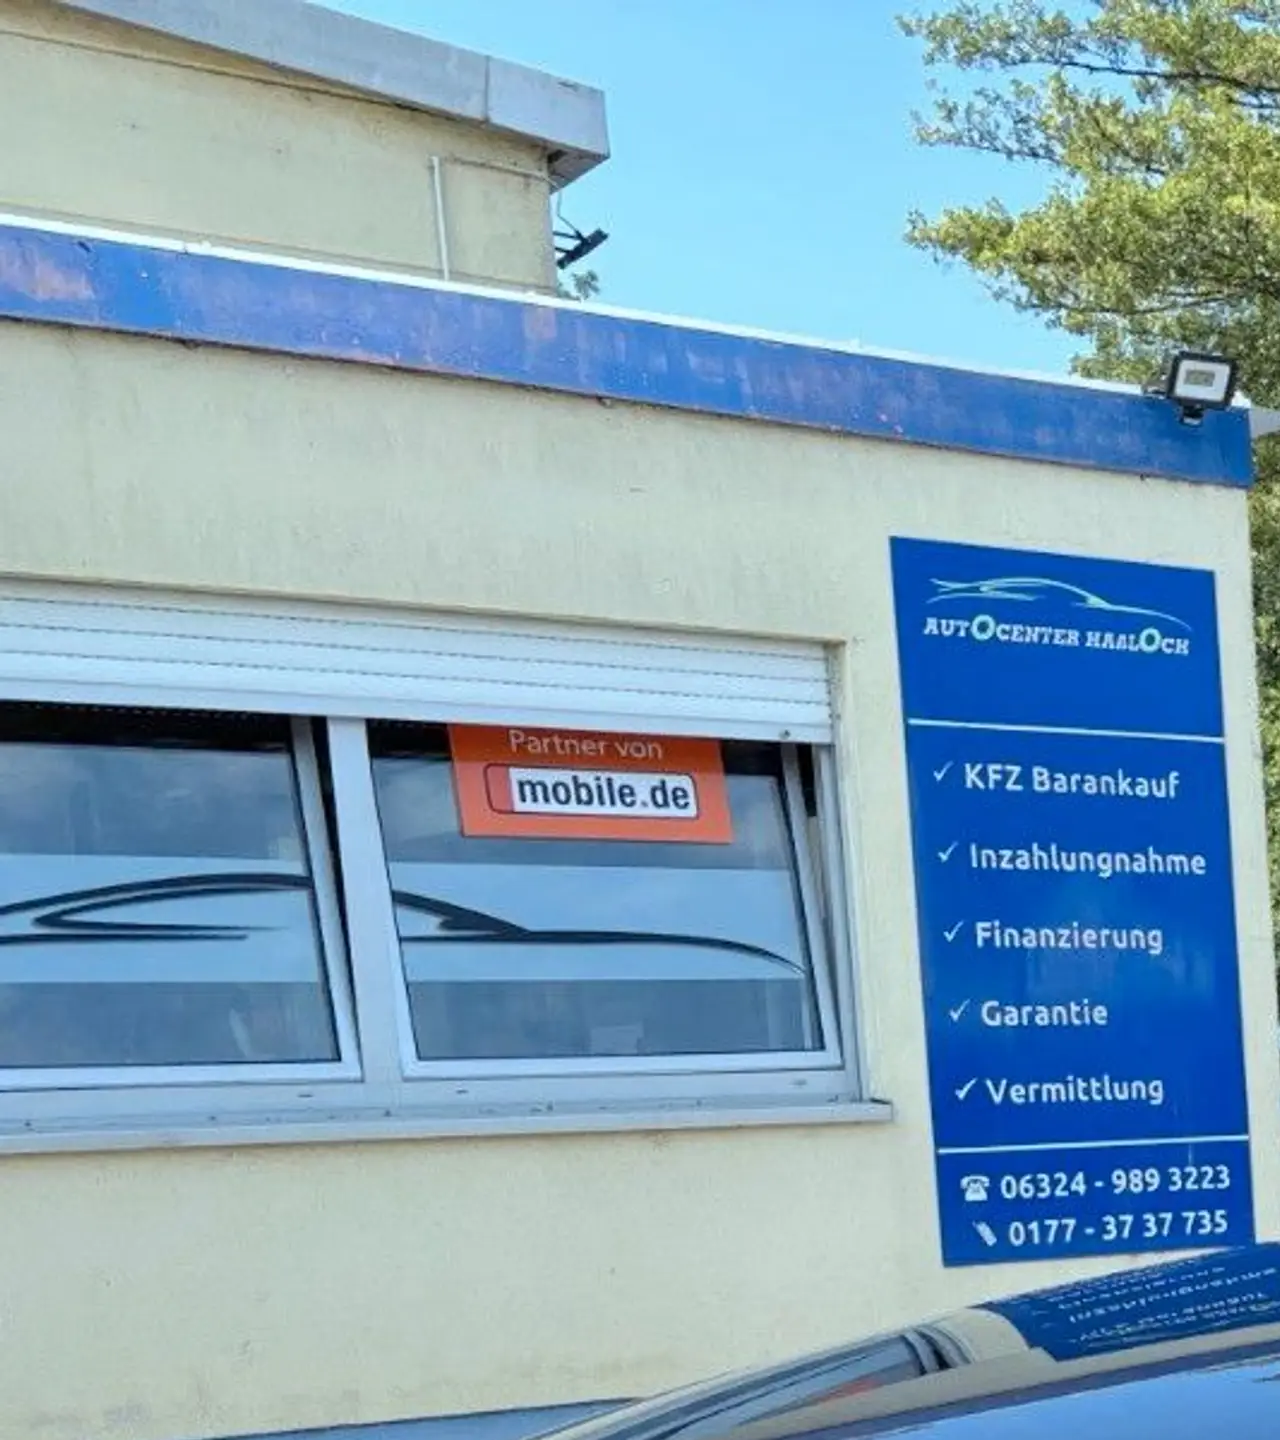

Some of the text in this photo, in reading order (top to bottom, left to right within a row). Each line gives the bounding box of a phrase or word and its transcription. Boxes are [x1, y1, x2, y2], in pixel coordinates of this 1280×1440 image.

[508, 729, 663, 760] Partner von
[517, 774, 690, 810] mobile.de
[964, 763, 1180, 799] KFZ Barankauf
[969, 842, 1207, 879] Inzahlungnahme
[975, 920, 1163, 955] Finanzierung
[981, 999, 1109, 1027] Garantie
[985, 1074, 1164, 1105] Vermittlung
[1000, 1171, 1087, 1199] 06324
[1111, 1168, 1160, 1194] 989
[1168, 1165, 1231, 1191] 3223
[1008, 1219, 1077, 1246] 0177
[1102, 1214, 1134, 1240] 37
[1143, 1212, 1173, 1237] 37
[1181, 1209, 1229, 1236] 735
